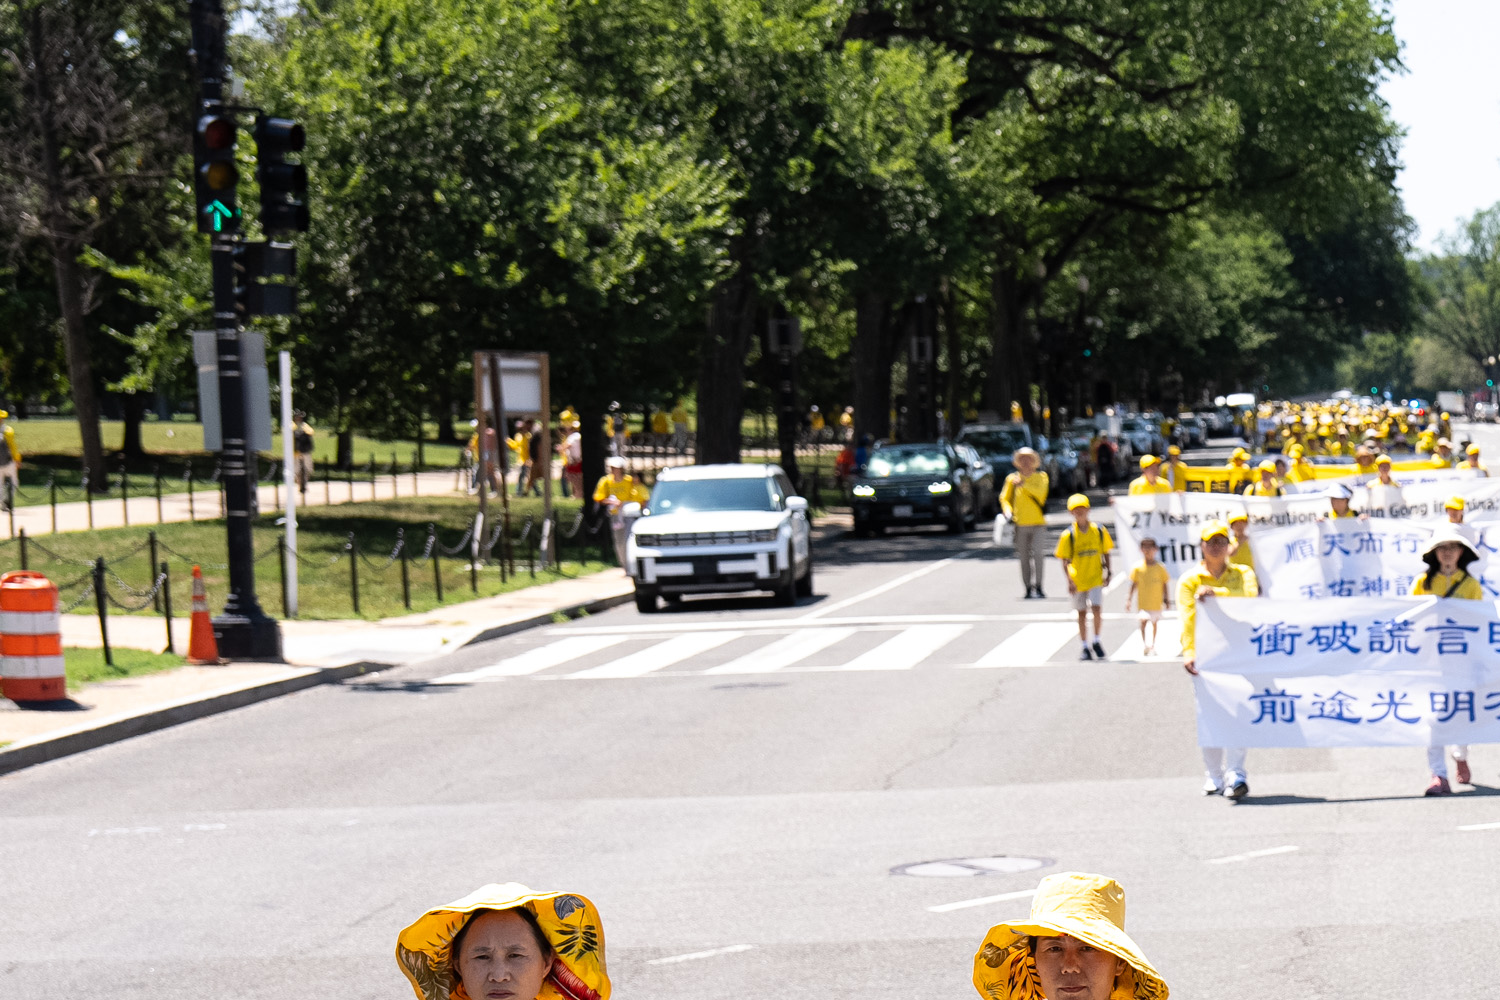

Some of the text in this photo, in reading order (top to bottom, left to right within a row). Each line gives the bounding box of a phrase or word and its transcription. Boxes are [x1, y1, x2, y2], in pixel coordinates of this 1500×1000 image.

[1130, 511, 1152, 529] 27
[1158, 510, 1201, 526] Years
[1389, 502, 1428, 519] Gong
